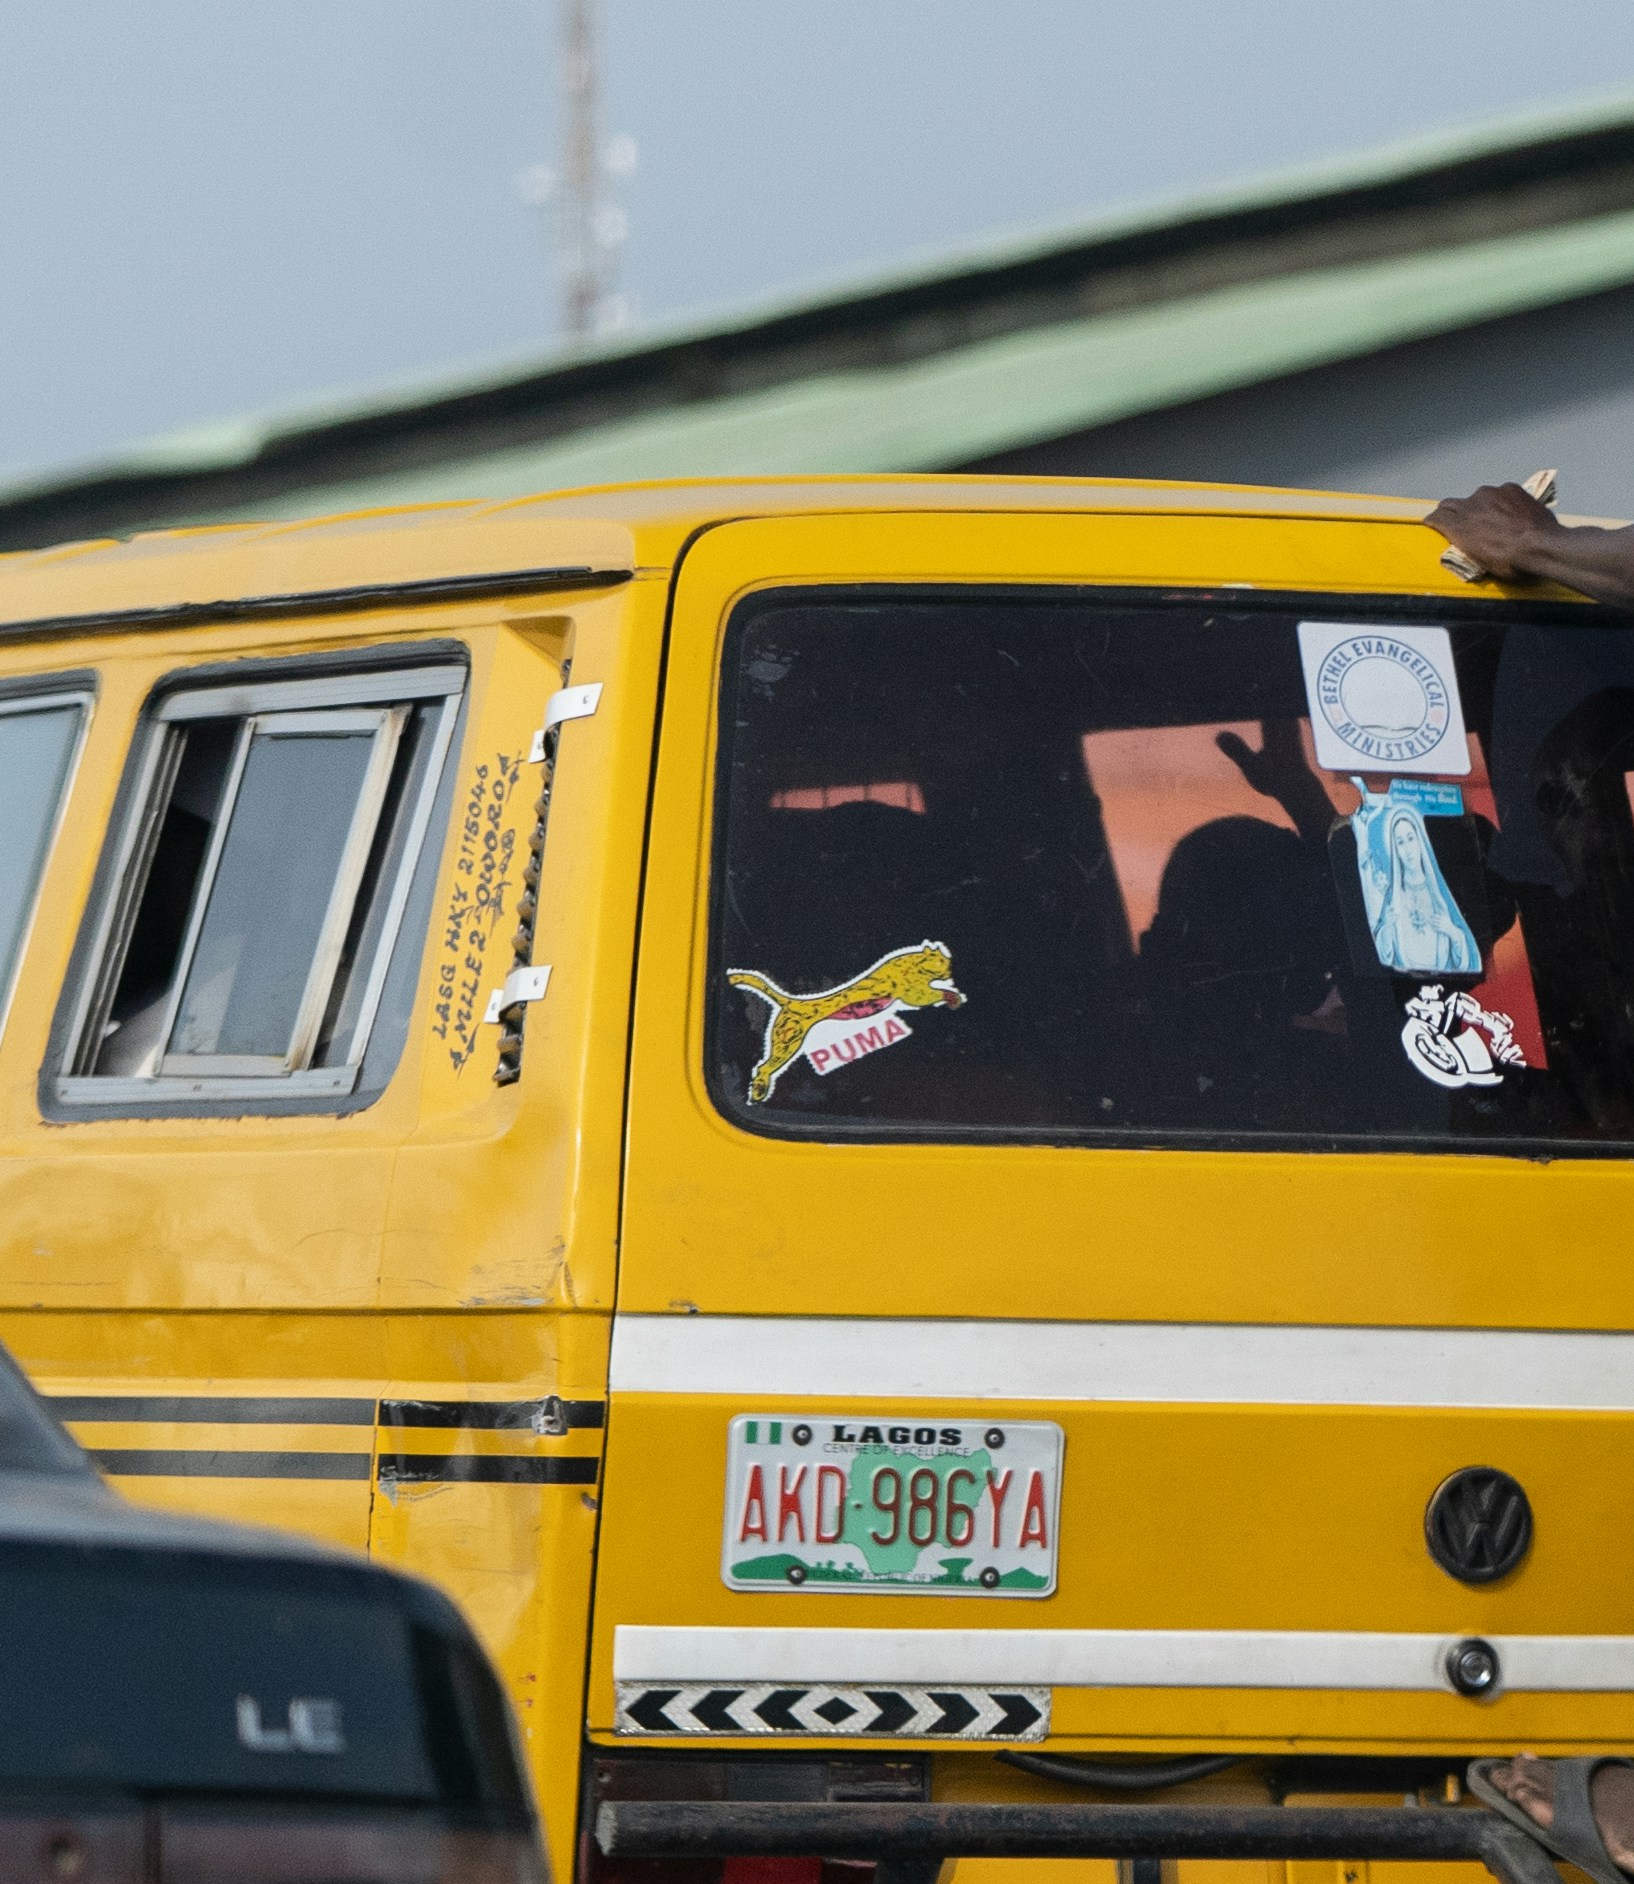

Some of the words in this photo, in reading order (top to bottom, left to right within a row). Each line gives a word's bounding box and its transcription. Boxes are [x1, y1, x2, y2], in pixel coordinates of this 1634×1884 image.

[1323, 652, 1352, 706] BETHEL
[1352, 640, 1445, 708] EVANGELICAL
[1337, 722, 1441, 759] MINISTRIES
[432, 963, 456, 1040] LASG
[458, 764, 489, 876] 2115046
[454, 952, 483, 1044] MILE
[809, 1018, 906, 1073] PUMA
[822, 1443, 869, 1455] CENTRE
[892, 1445, 970, 1458] EXCELLENCE
[832, 1425, 962, 1446] LAGOS
[236, 1692, 346, 1755] LE
